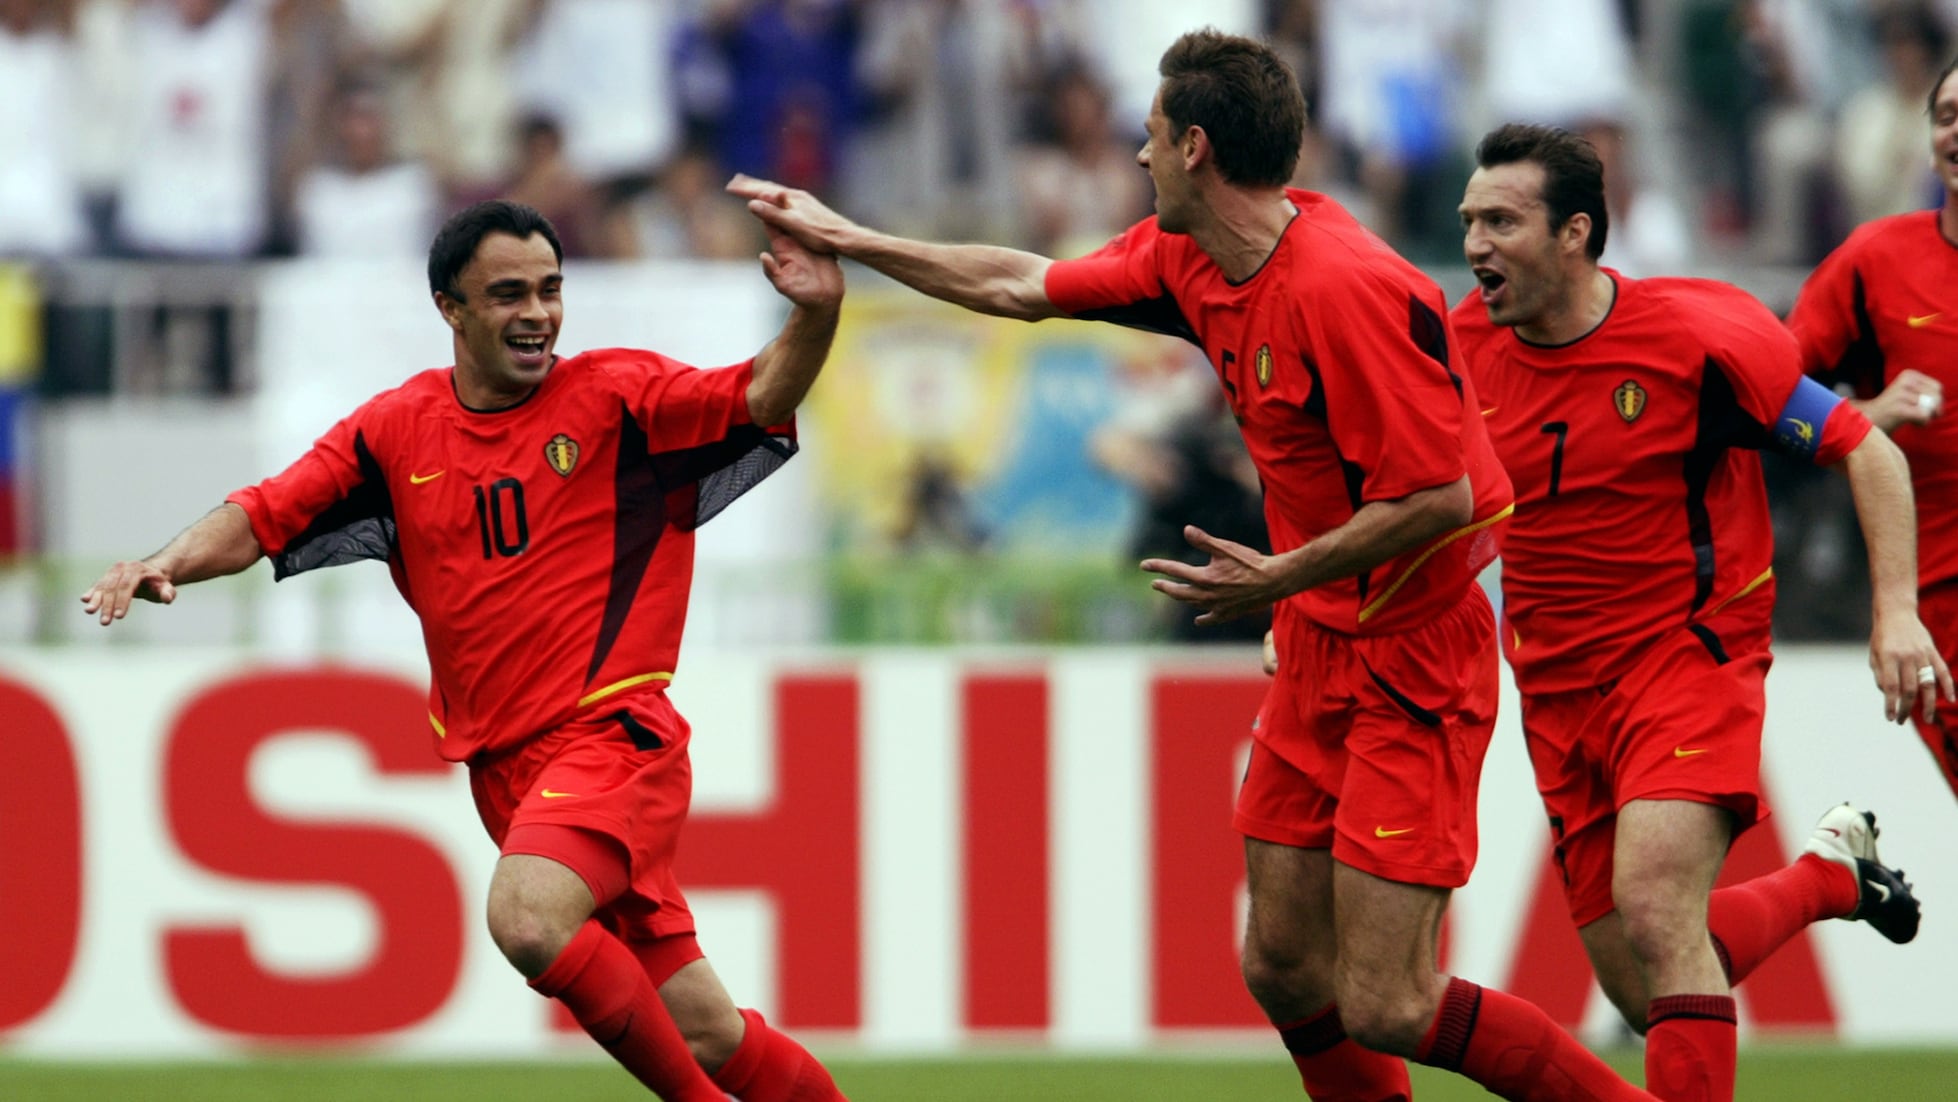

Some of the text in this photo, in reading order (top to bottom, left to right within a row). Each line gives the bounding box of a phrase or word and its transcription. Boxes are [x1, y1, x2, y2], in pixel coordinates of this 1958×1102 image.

[1540, 421, 1568, 496] 7
[473, 477, 529, 560] 10
[0, 665, 1841, 1042] SHIA
